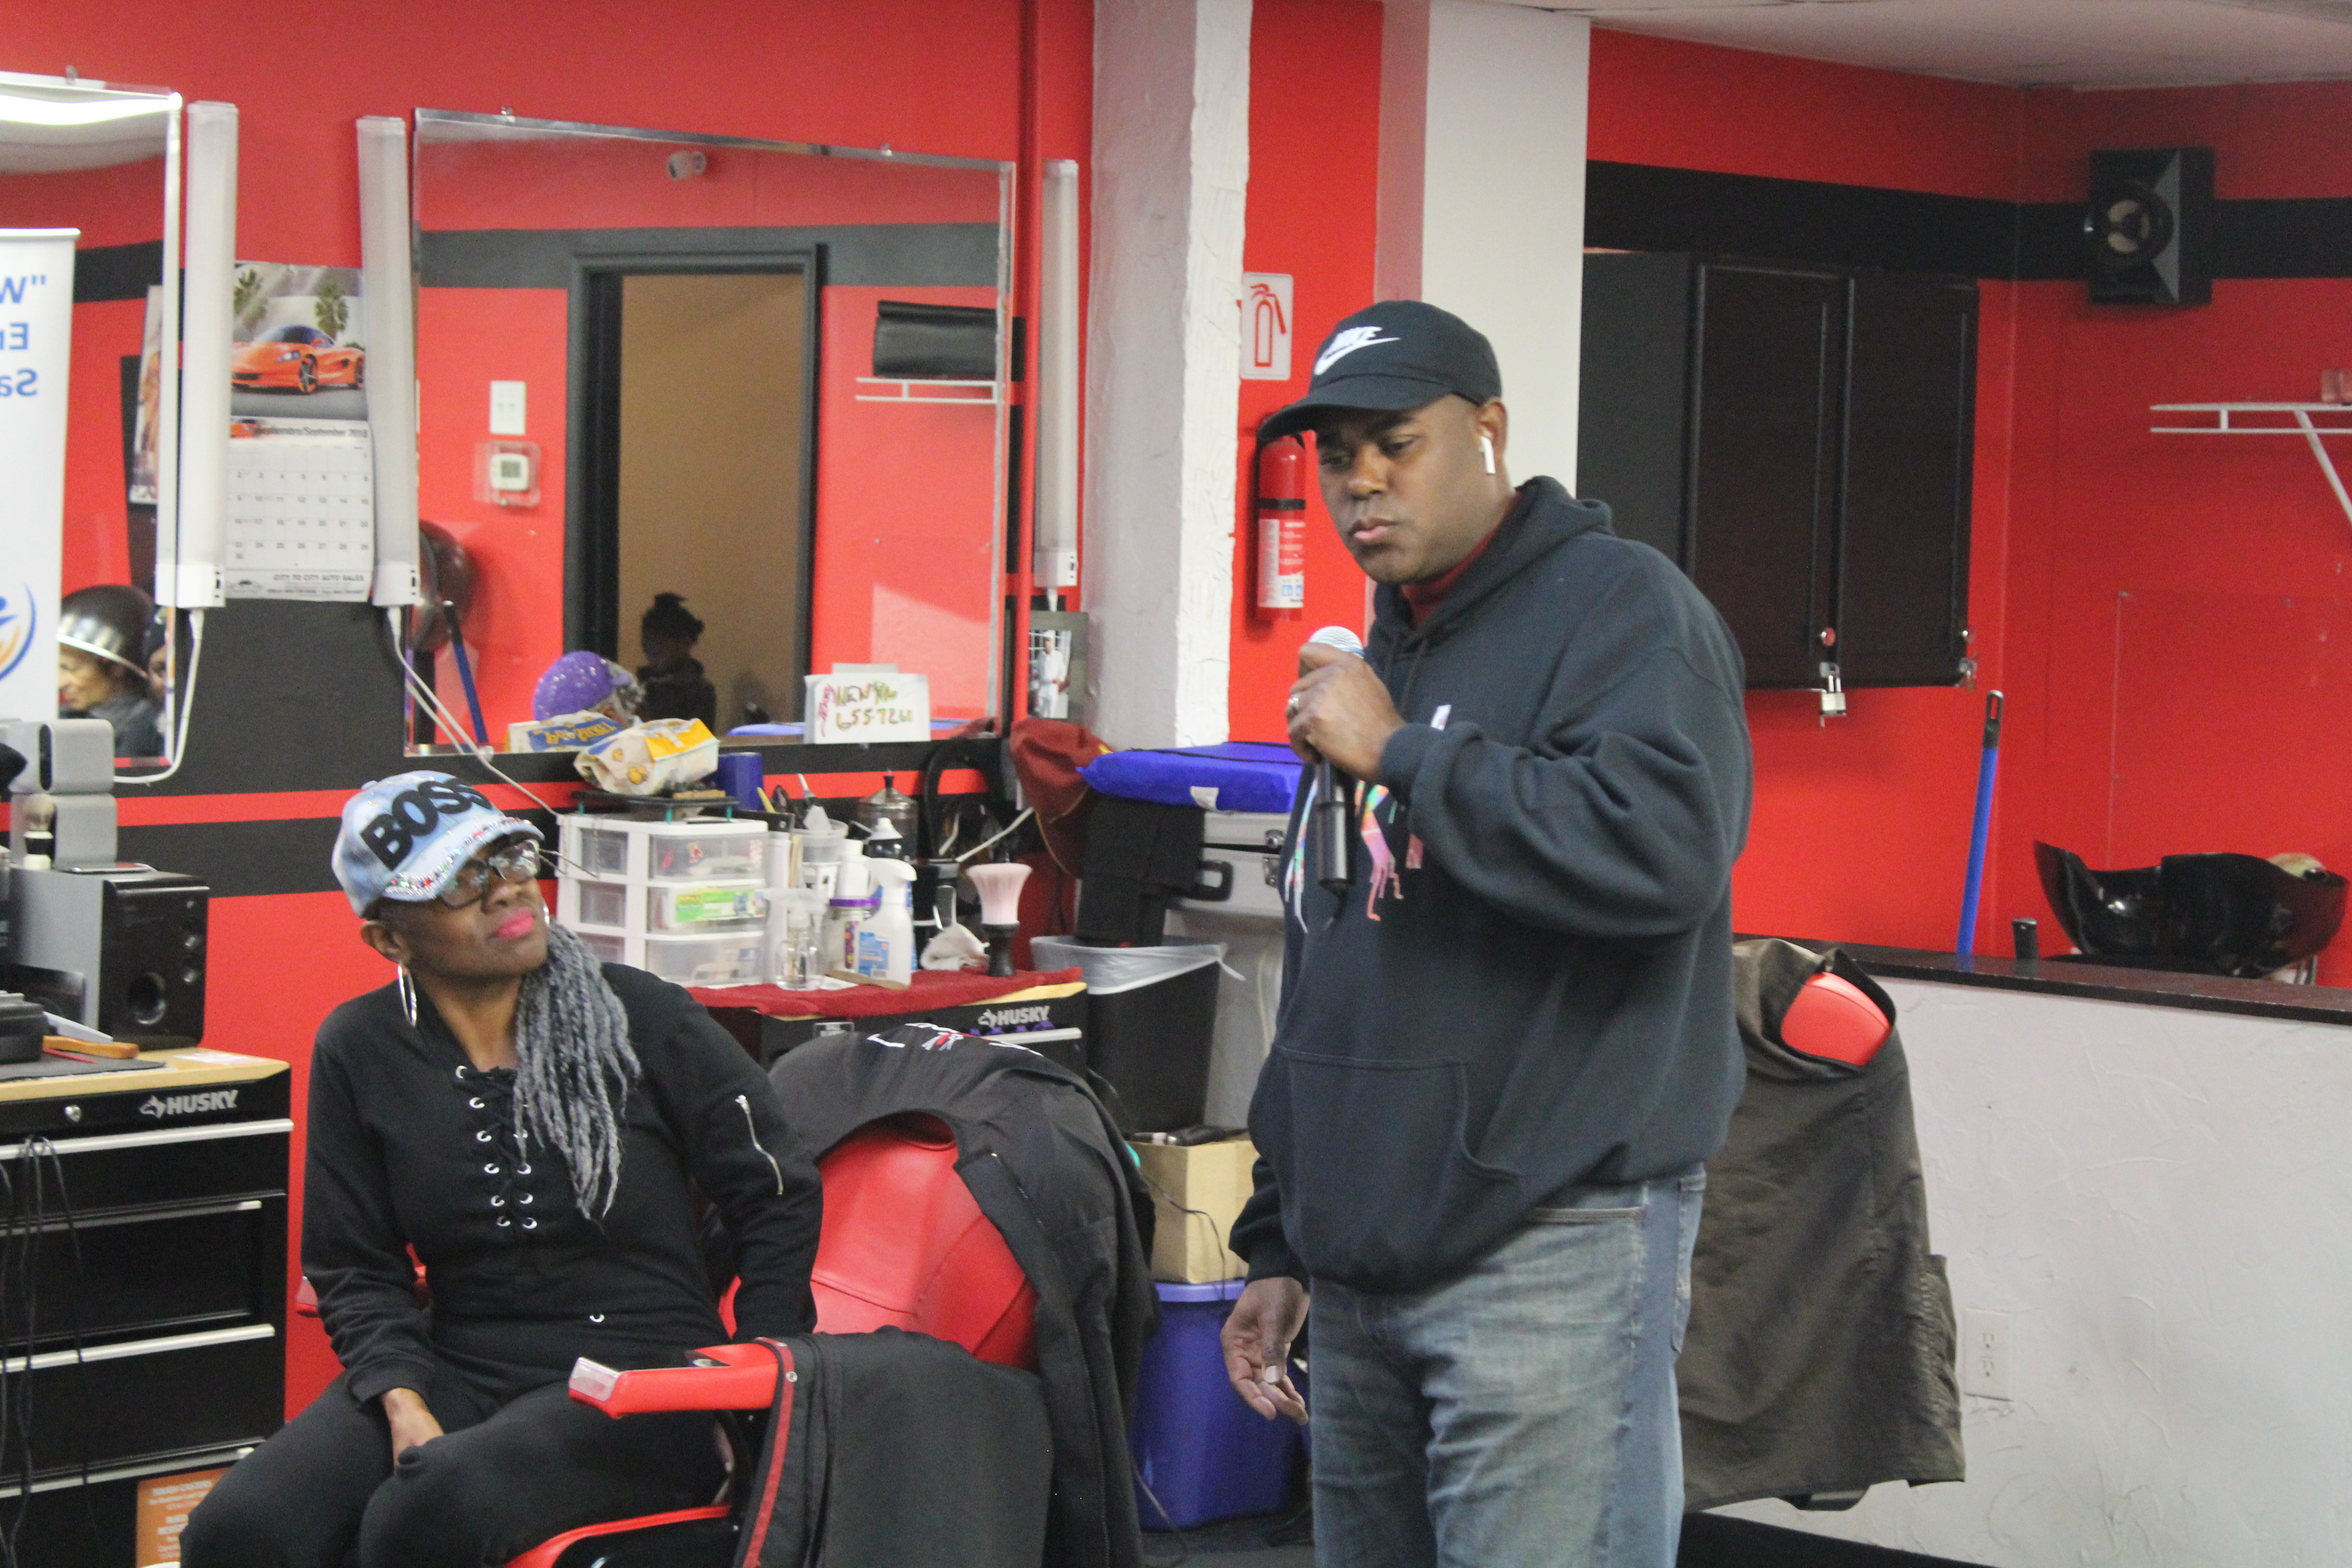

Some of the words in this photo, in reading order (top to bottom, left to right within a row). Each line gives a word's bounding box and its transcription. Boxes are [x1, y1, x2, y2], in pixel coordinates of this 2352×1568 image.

[361, 778, 493, 871] BOSS
[997, 1005, 1050, 1026] HUSKY
[166, 1089, 238, 1115] HUSKY
